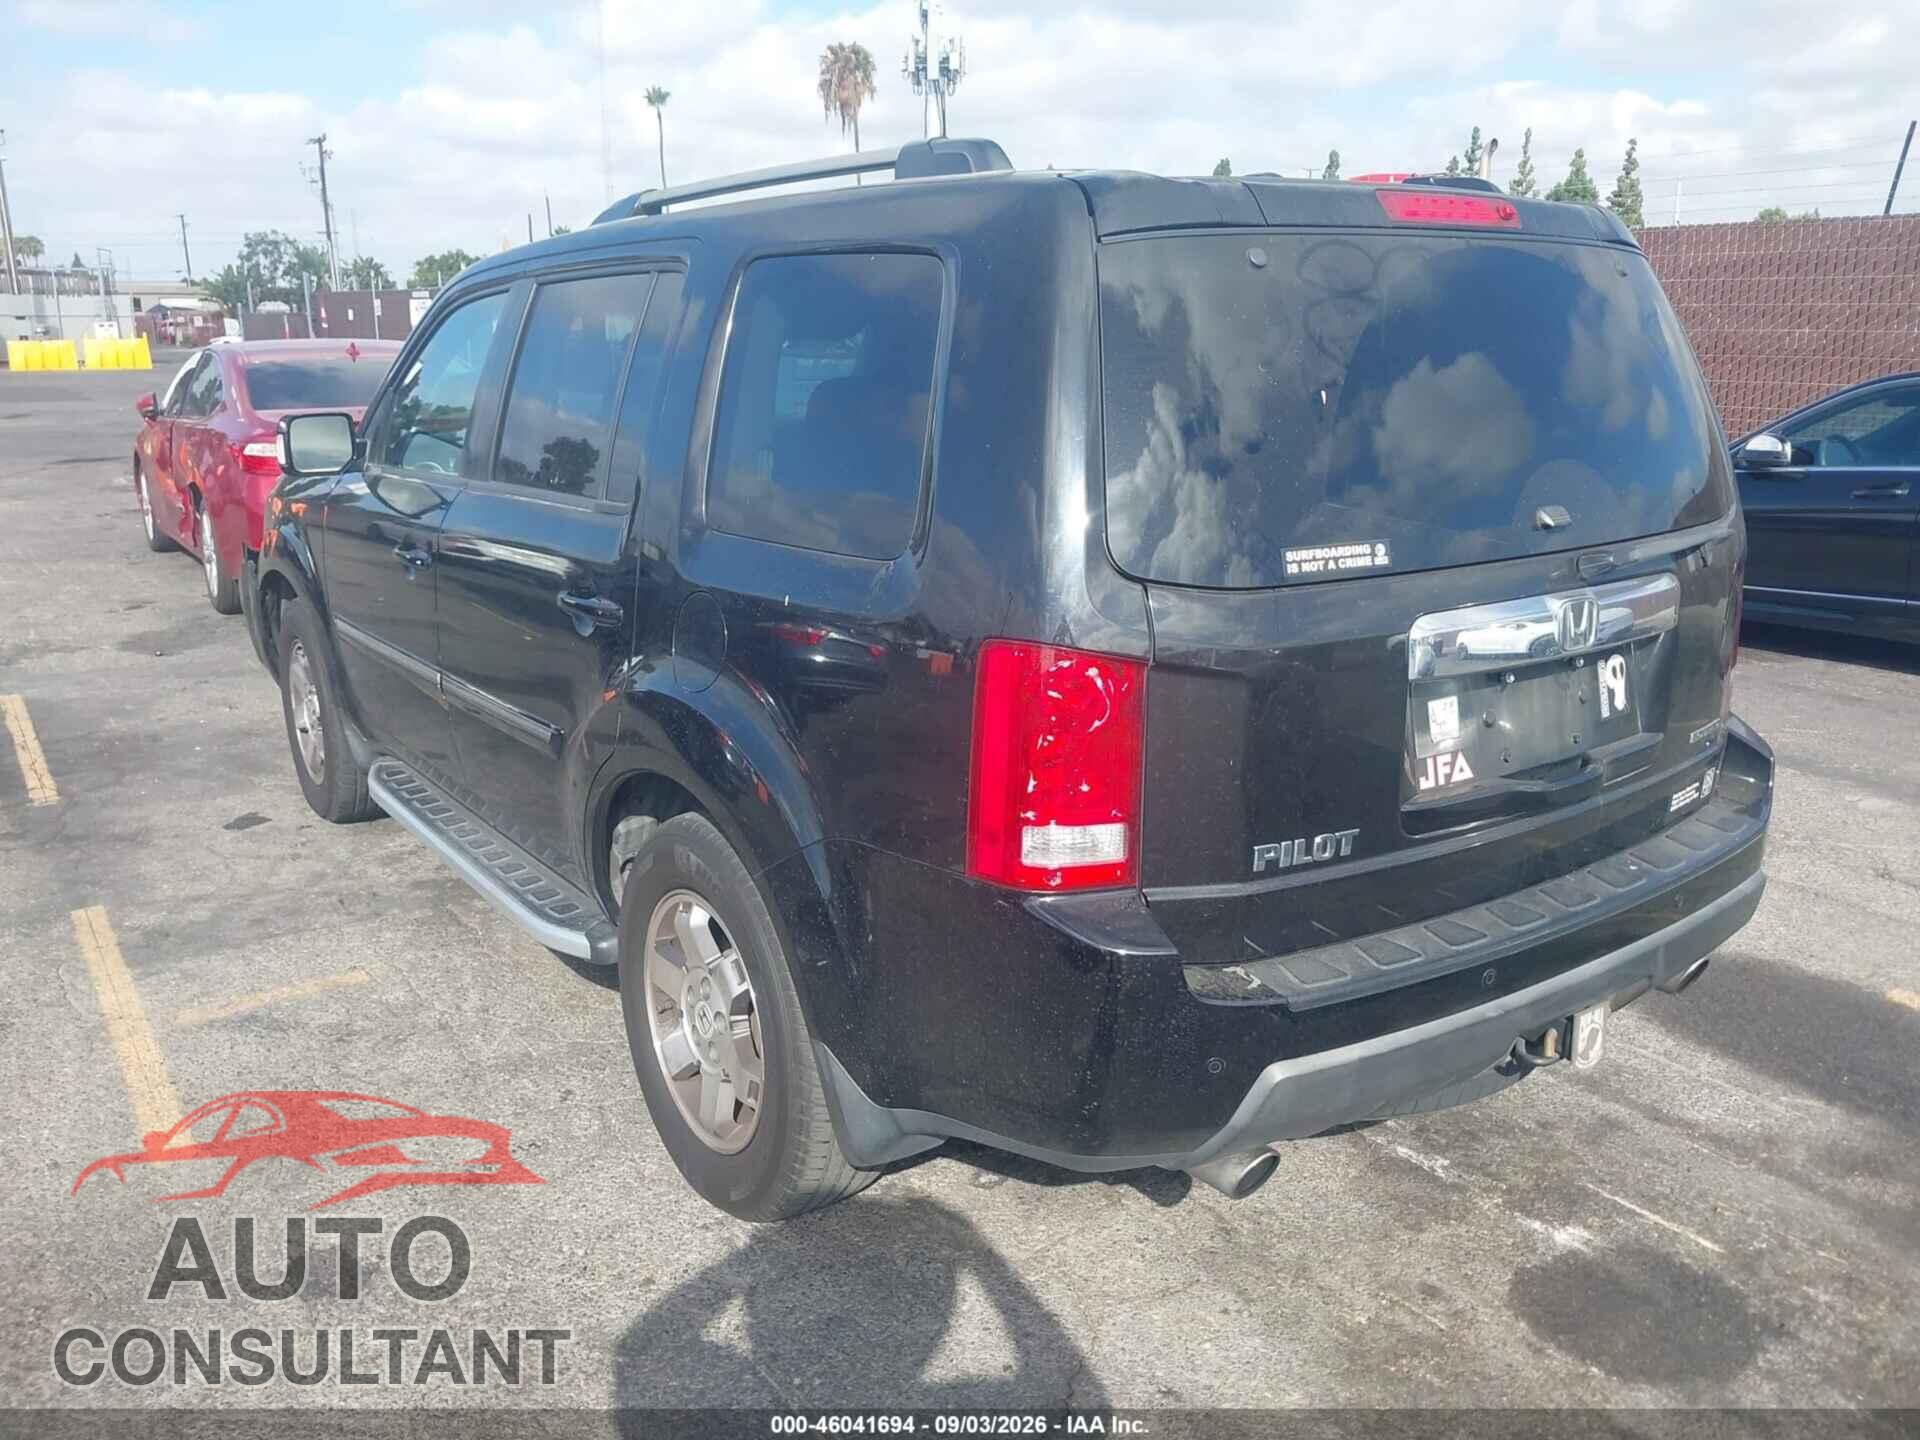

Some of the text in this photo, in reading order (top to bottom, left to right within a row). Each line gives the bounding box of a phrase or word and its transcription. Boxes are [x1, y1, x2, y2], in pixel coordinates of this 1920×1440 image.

[1285, 543, 1371, 562] SURFBOARDING
[1286, 562, 1299, 574] IS
[1301, 560, 1325, 572] NOT
[1327, 558, 1337, 570] A
[1338, 556, 1373, 569] CRIME
[1419, 750, 1474, 790] JFA
[1253, 828, 1360, 872] PILOT
